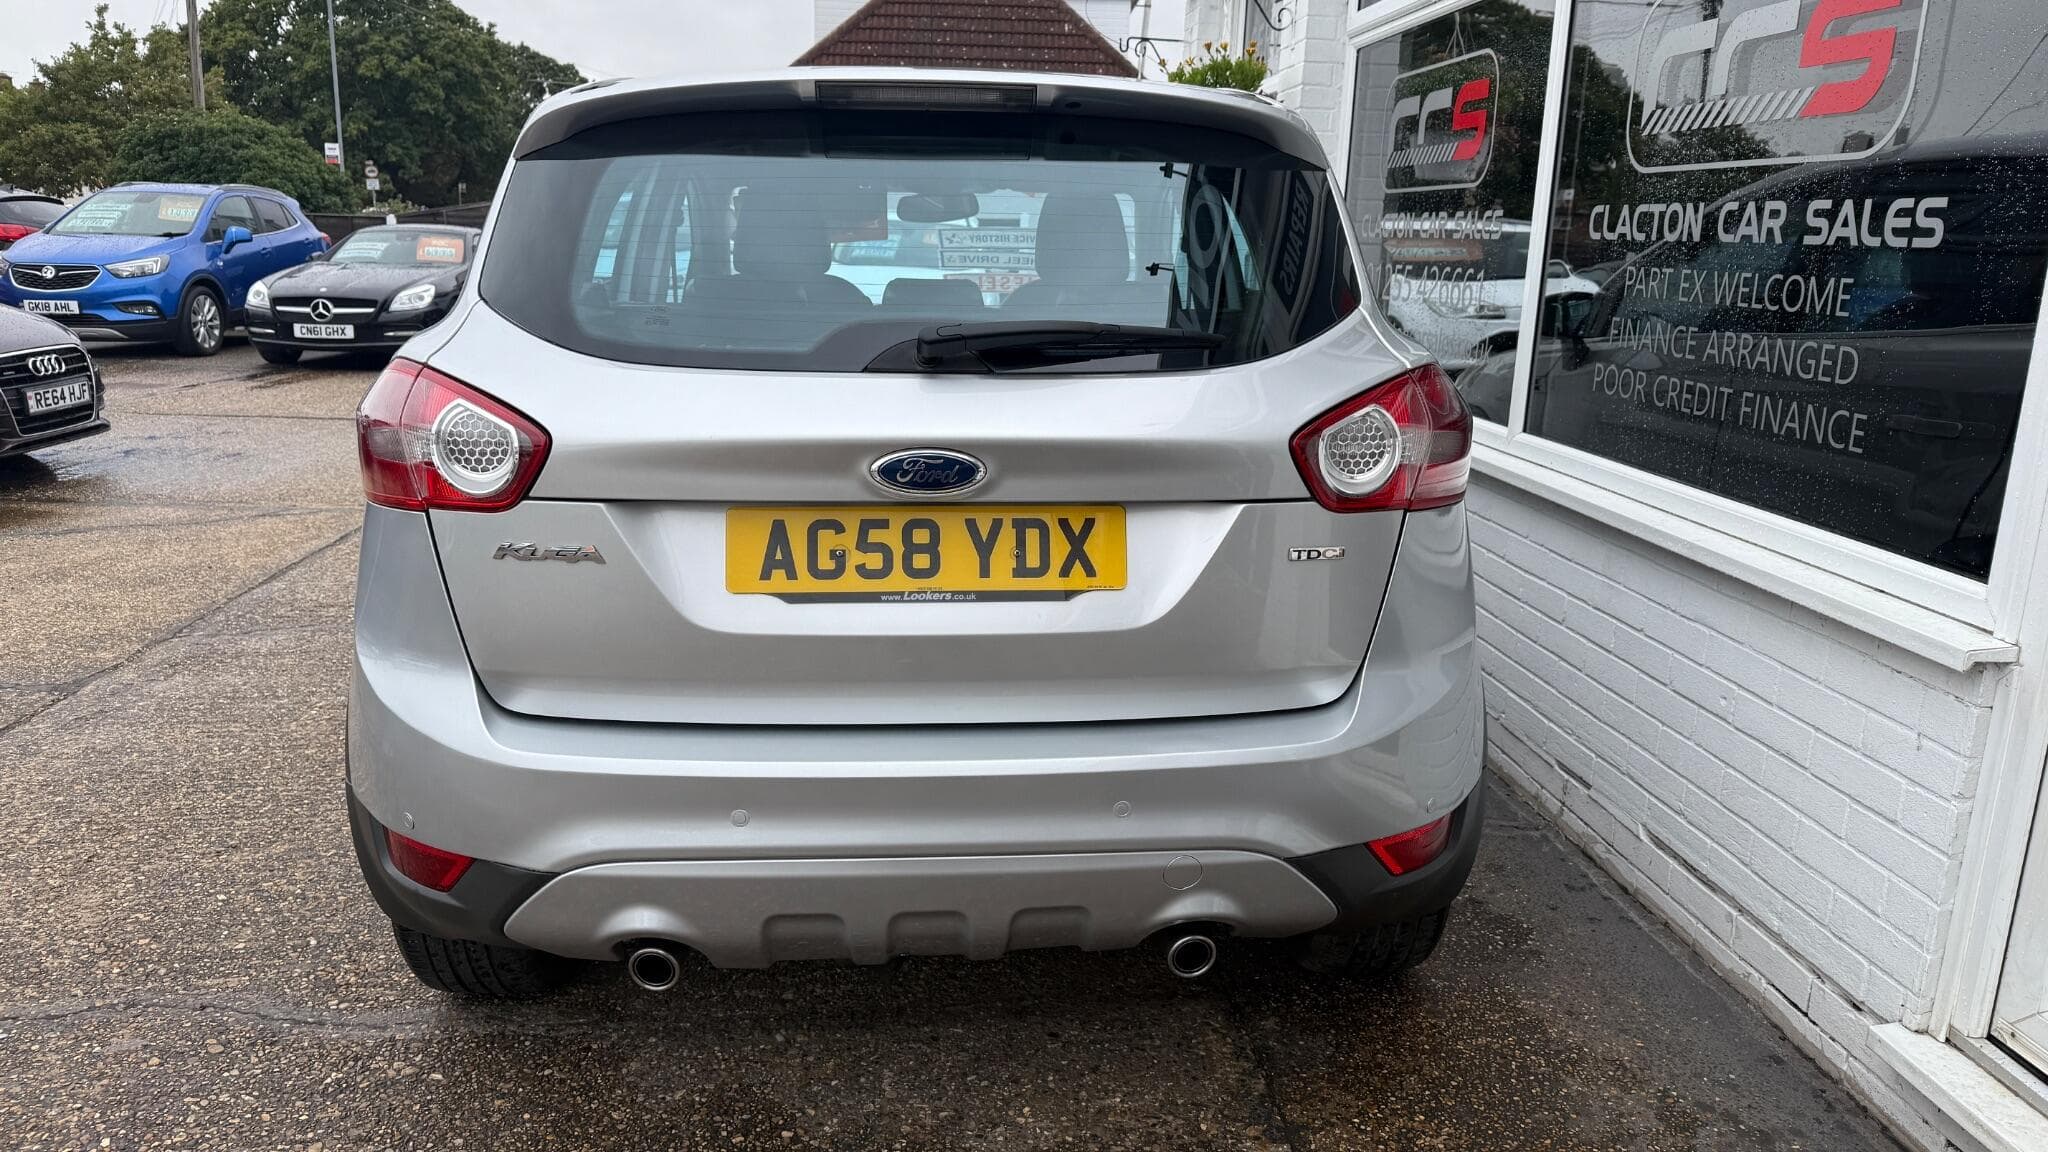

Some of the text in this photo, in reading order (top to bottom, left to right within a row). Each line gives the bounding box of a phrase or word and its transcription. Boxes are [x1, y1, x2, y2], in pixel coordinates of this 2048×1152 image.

[1362, 209, 1504, 239] CLACTON CAR SALES
[1588, 197, 1949, 248] CLACTON CAR SALES
[1416, 265, 1485, 310] 426661
[1624, 266, 1854, 318] PART EX WELCOME
[28, 301, 75, 313] GK18 AHL
[300, 325, 347, 337] CN61 GHX
[1609, 316, 1860, 385] FINANCE ARRANGED
[34, 382, 87, 410] RE64 HJF
[1592, 362, 1869, 454] POOR CREDIT FINANCE
[896, 457, 960, 483] Ford
[758, 517, 1097, 581] AG58 YDX
[880, 591, 977, 601] www.Lookers.co.uk
